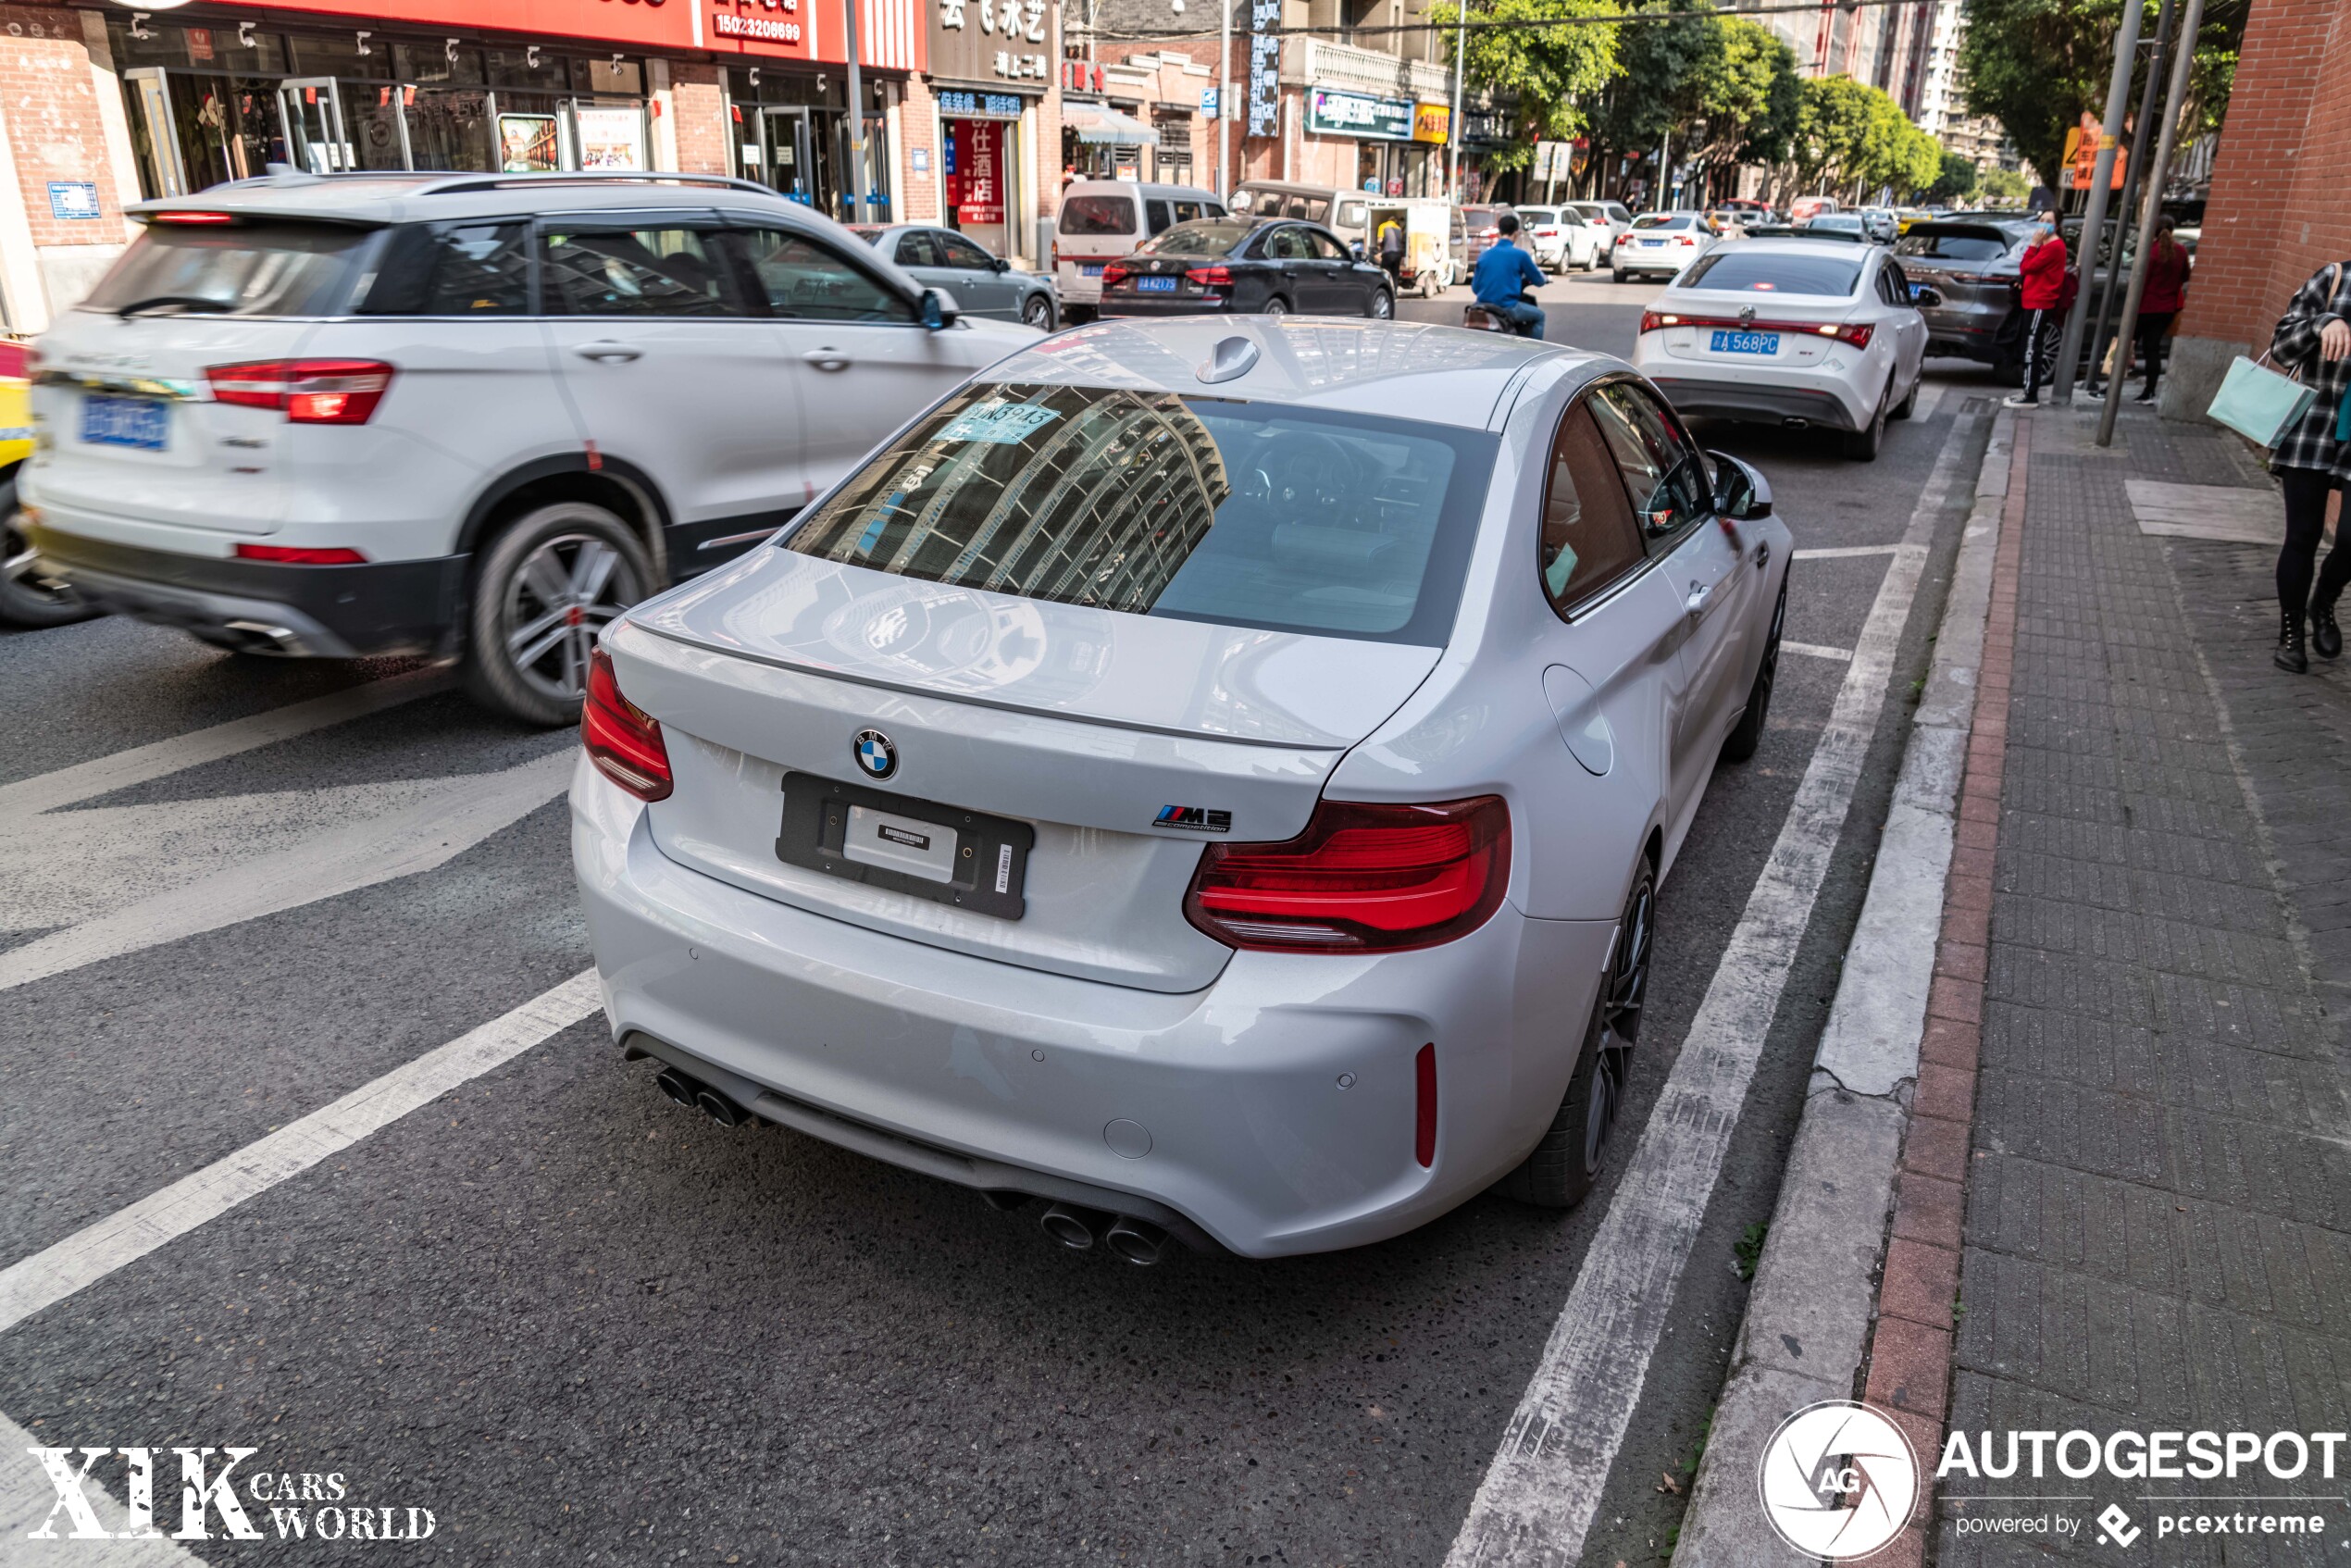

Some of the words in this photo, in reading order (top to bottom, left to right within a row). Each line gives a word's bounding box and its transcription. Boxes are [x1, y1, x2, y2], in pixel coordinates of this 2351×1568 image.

[717, 14, 801, 41] 15023206699
[857, 731, 892, 751] BMW
[1167, 822, 1227, 832] competition
[1176, 807, 1232, 827] M2
